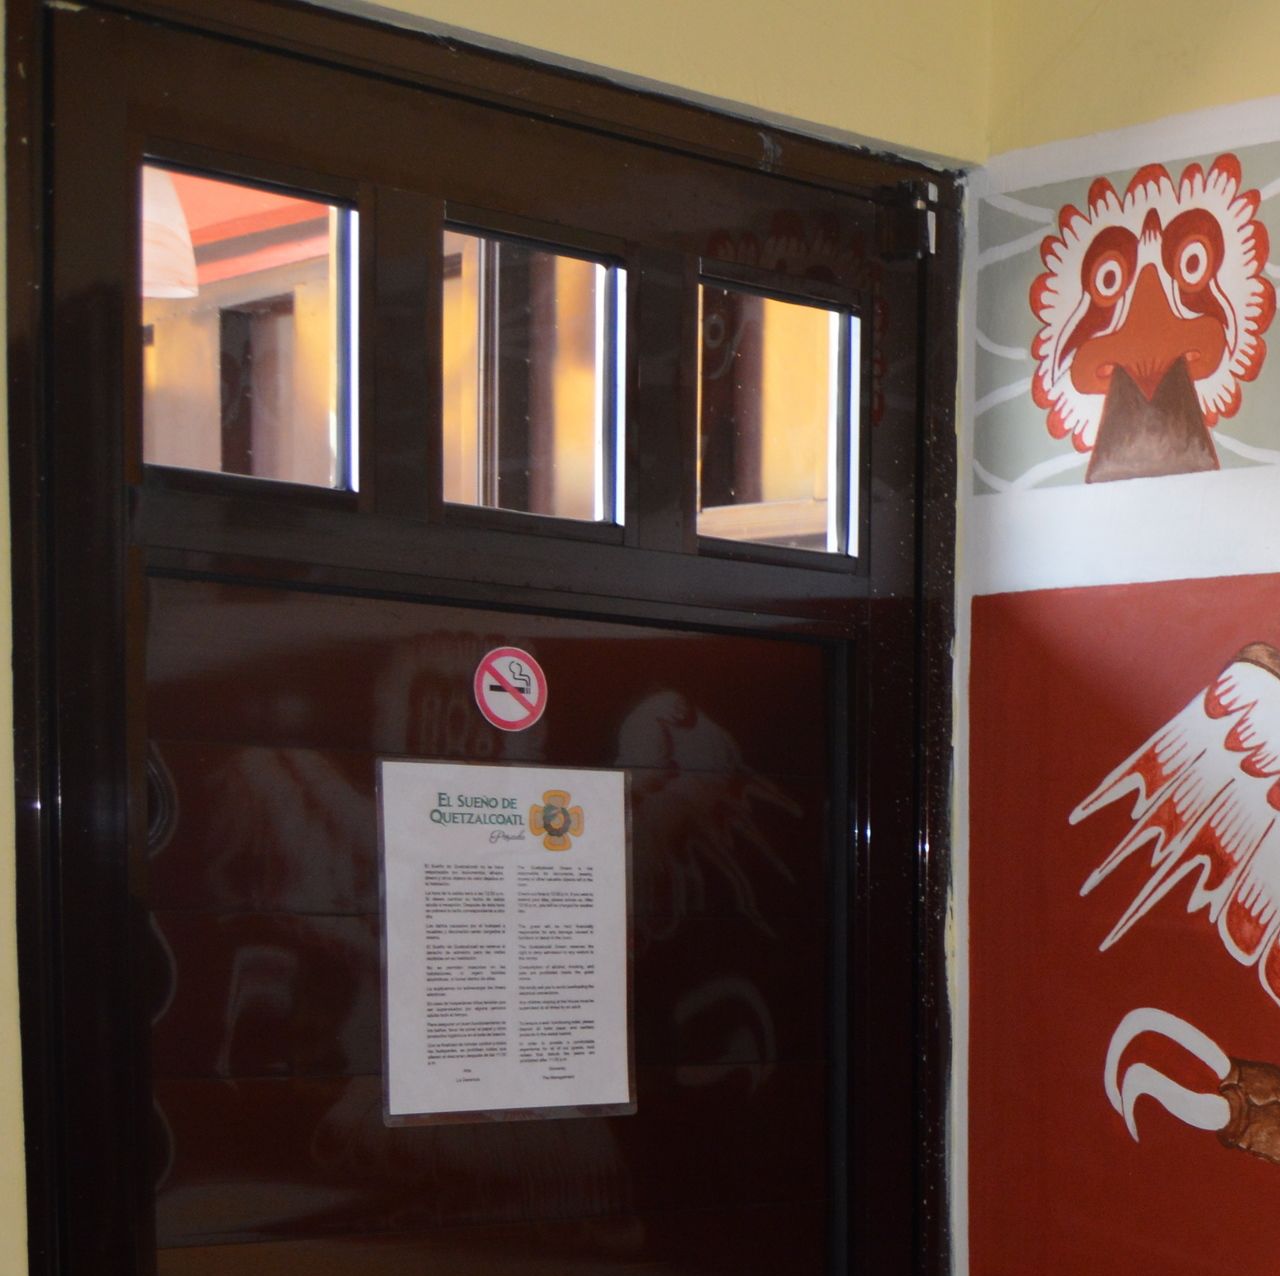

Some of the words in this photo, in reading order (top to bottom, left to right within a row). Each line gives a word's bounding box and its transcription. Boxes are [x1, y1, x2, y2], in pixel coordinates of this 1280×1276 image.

[437, 792, 452, 808] EL
[457, 794, 498, 809] SUEÑO
[502, 797, 517, 809] DE
[430, 808, 525, 827] QUETZALCOATL
